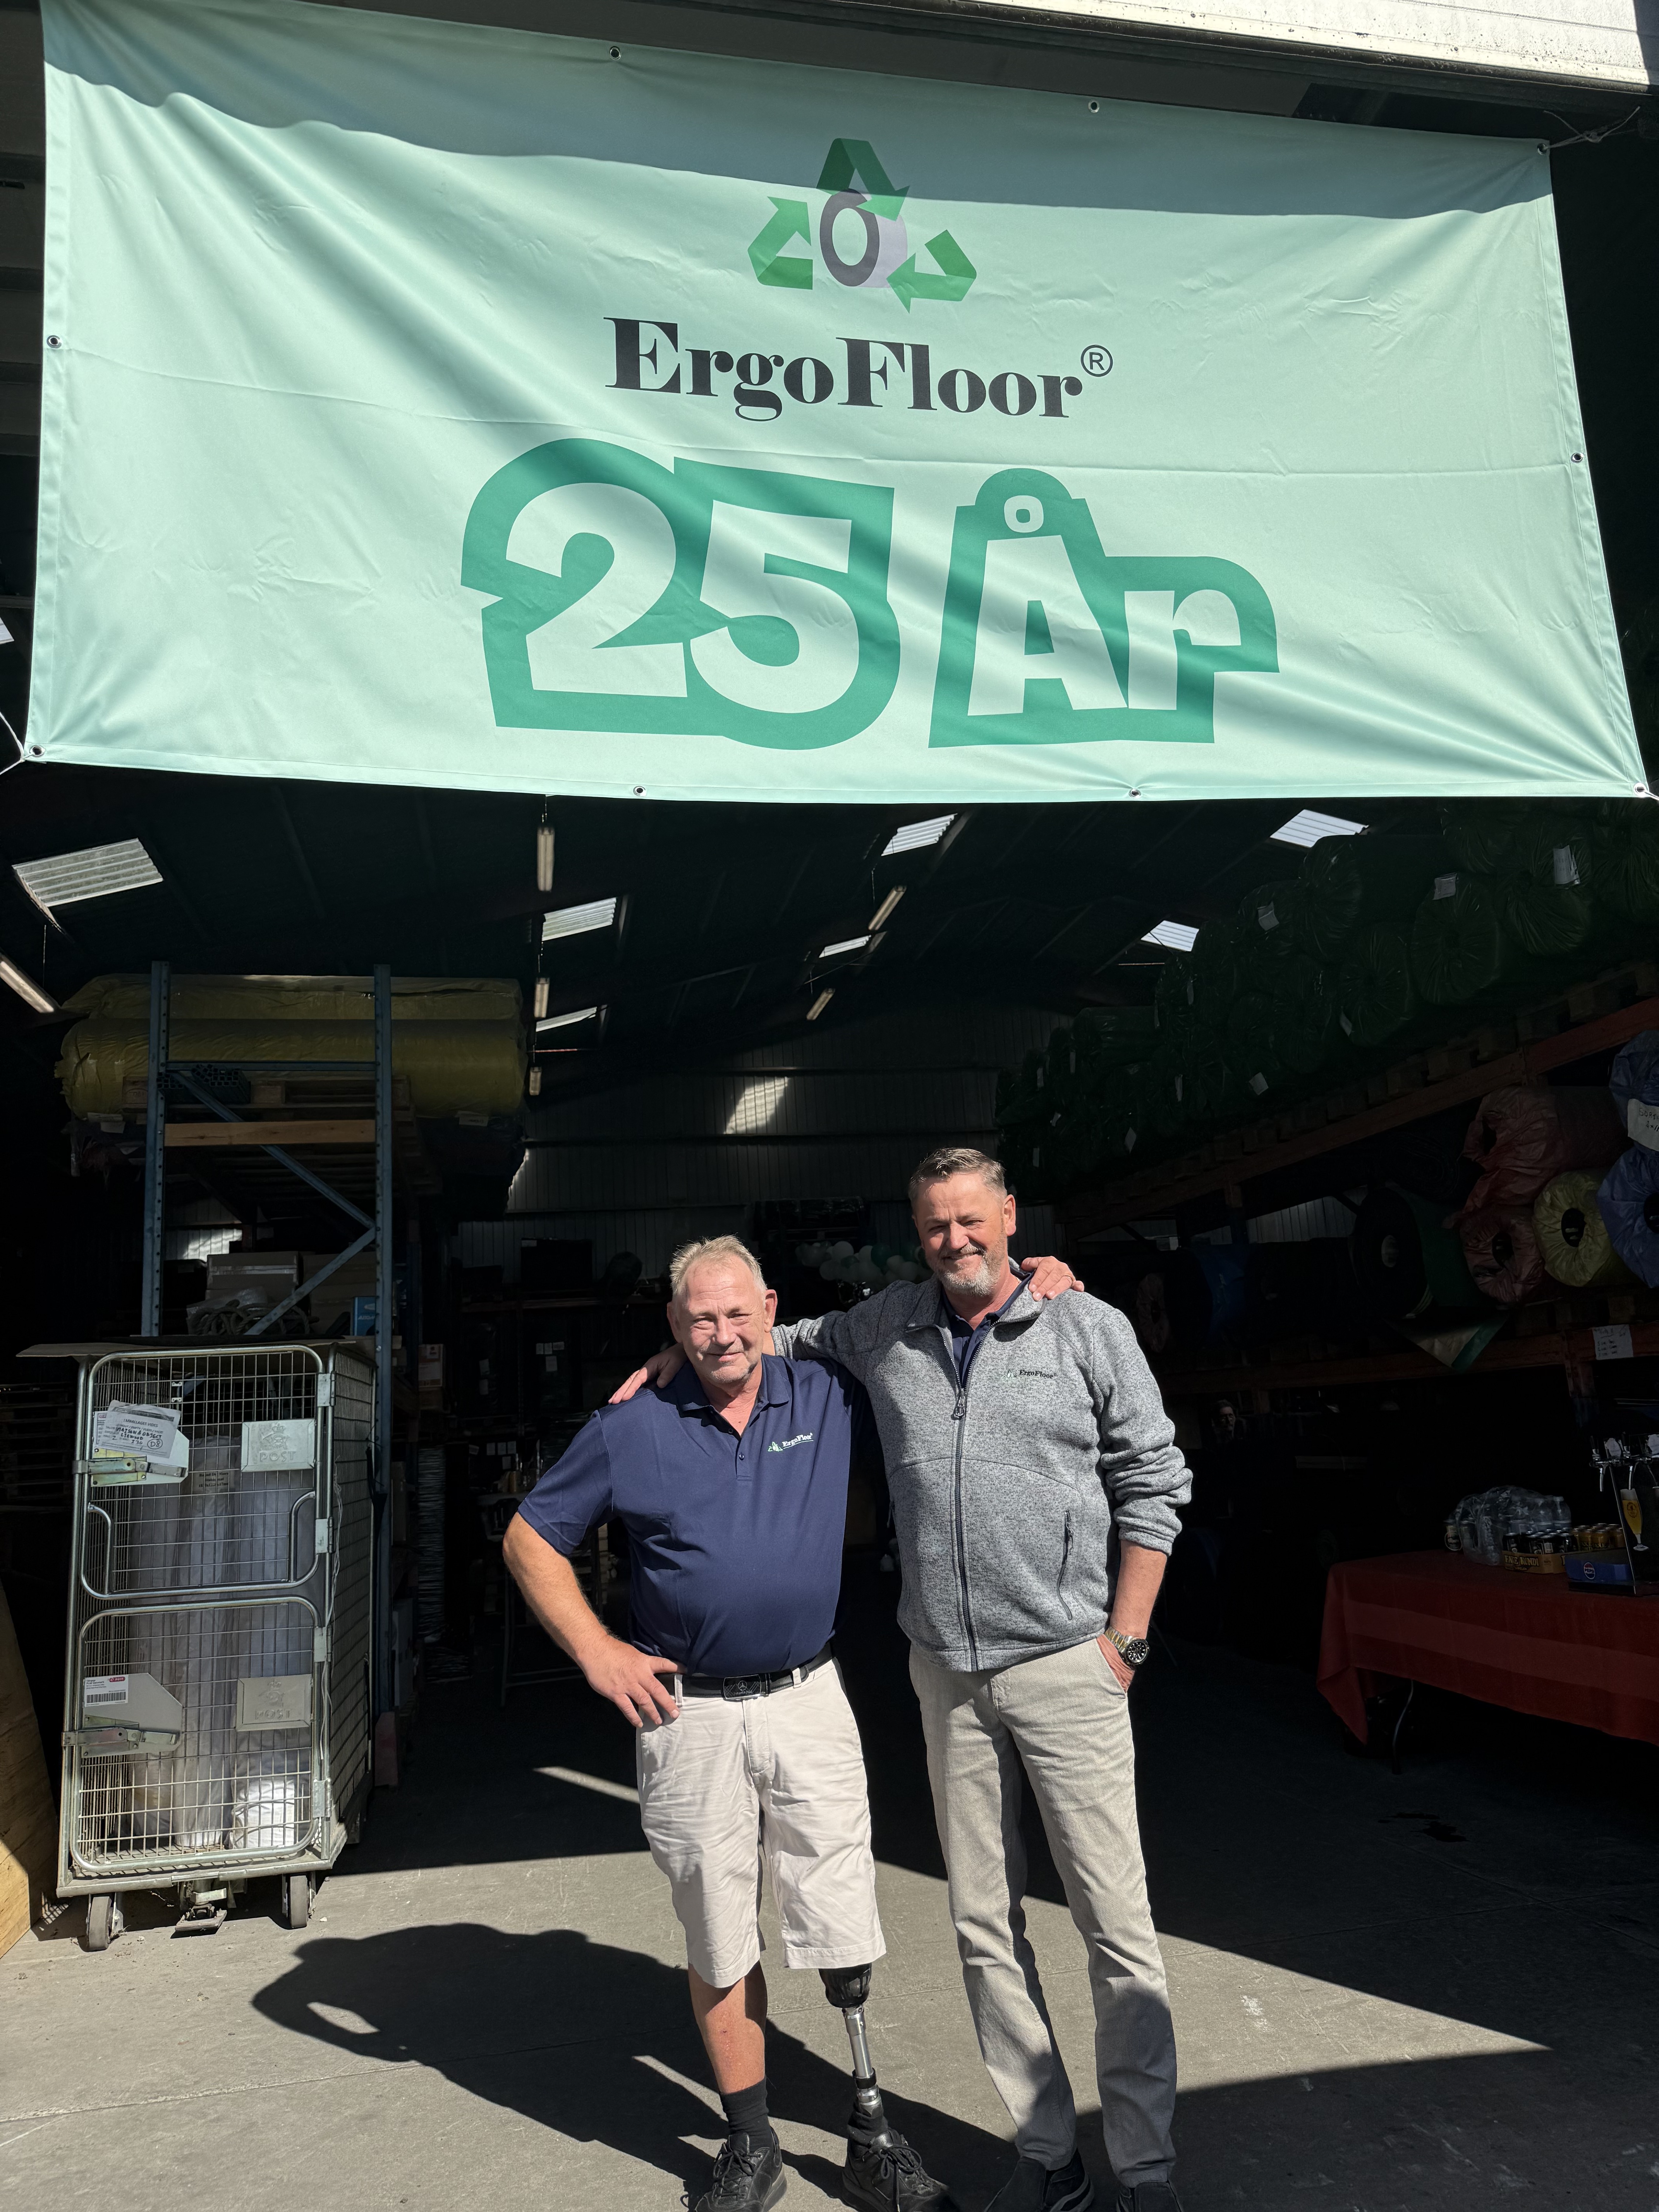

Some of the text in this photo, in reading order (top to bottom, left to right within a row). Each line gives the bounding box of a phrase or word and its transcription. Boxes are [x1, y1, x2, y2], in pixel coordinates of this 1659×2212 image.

[505, 483, 1242, 717] 25 År
[260, 1451, 296, 1462] POST
